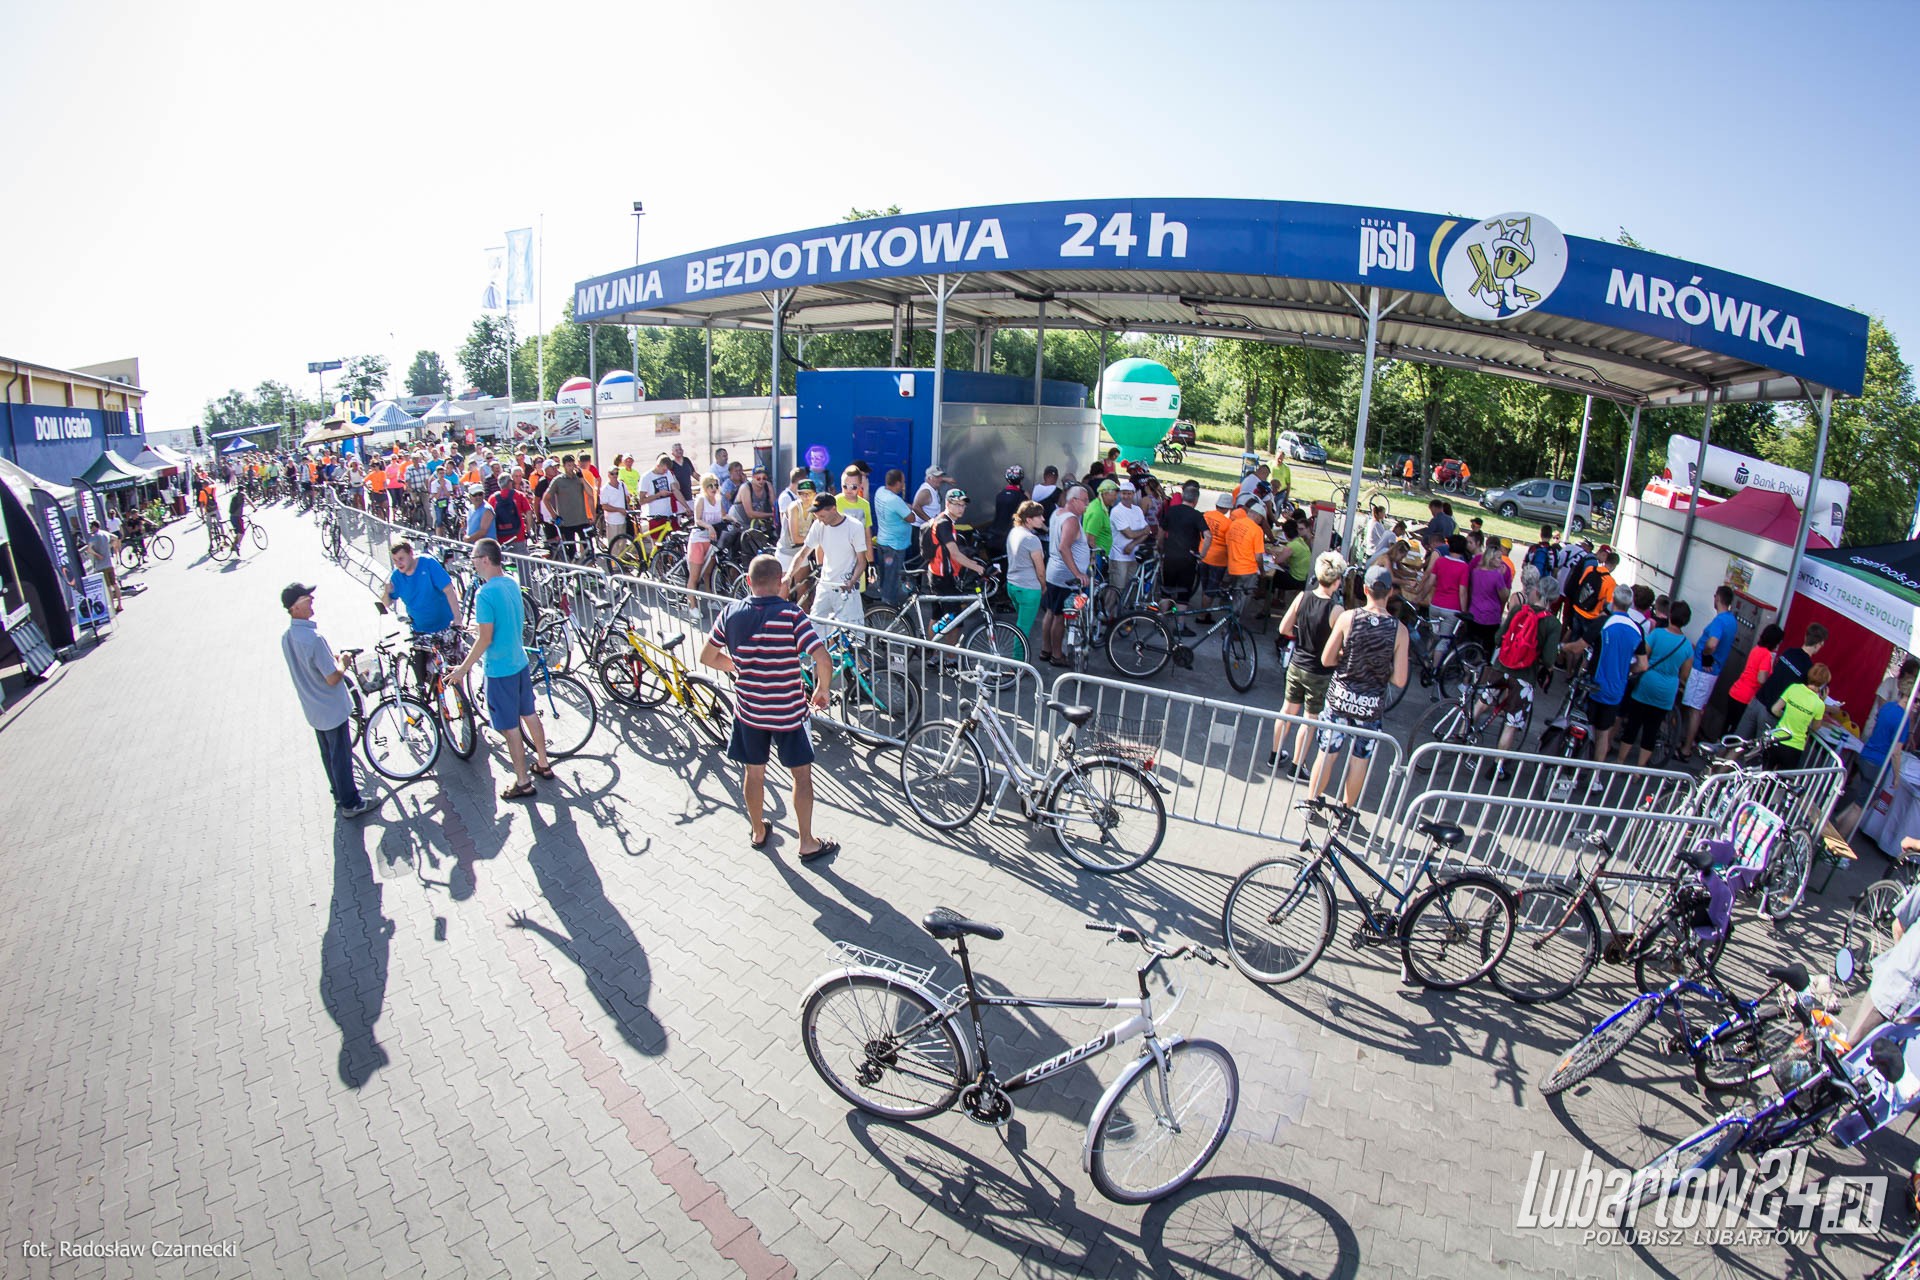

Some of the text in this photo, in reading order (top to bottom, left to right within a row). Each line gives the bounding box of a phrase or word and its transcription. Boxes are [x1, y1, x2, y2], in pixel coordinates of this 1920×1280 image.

[1360, 217, 1392, 228] GRUPA
[1358, 221, 1416, 276] psb
[577, 269, 664, 316] MYJNIA
[685, 217, 1009, 294] BEZDOTYKOWA
[1605, 267, 1805, 357] MRÓWKA
[34, 411, 92, 441] DOM I OGRÓD
[1752, 473, 1805, 497] Bank Polski
[1837, 588, 1863, 609] TRADE
[1334, 685, 1380, 708] BOOMBOX
[1341, 701, 1366, 716] KIDS
